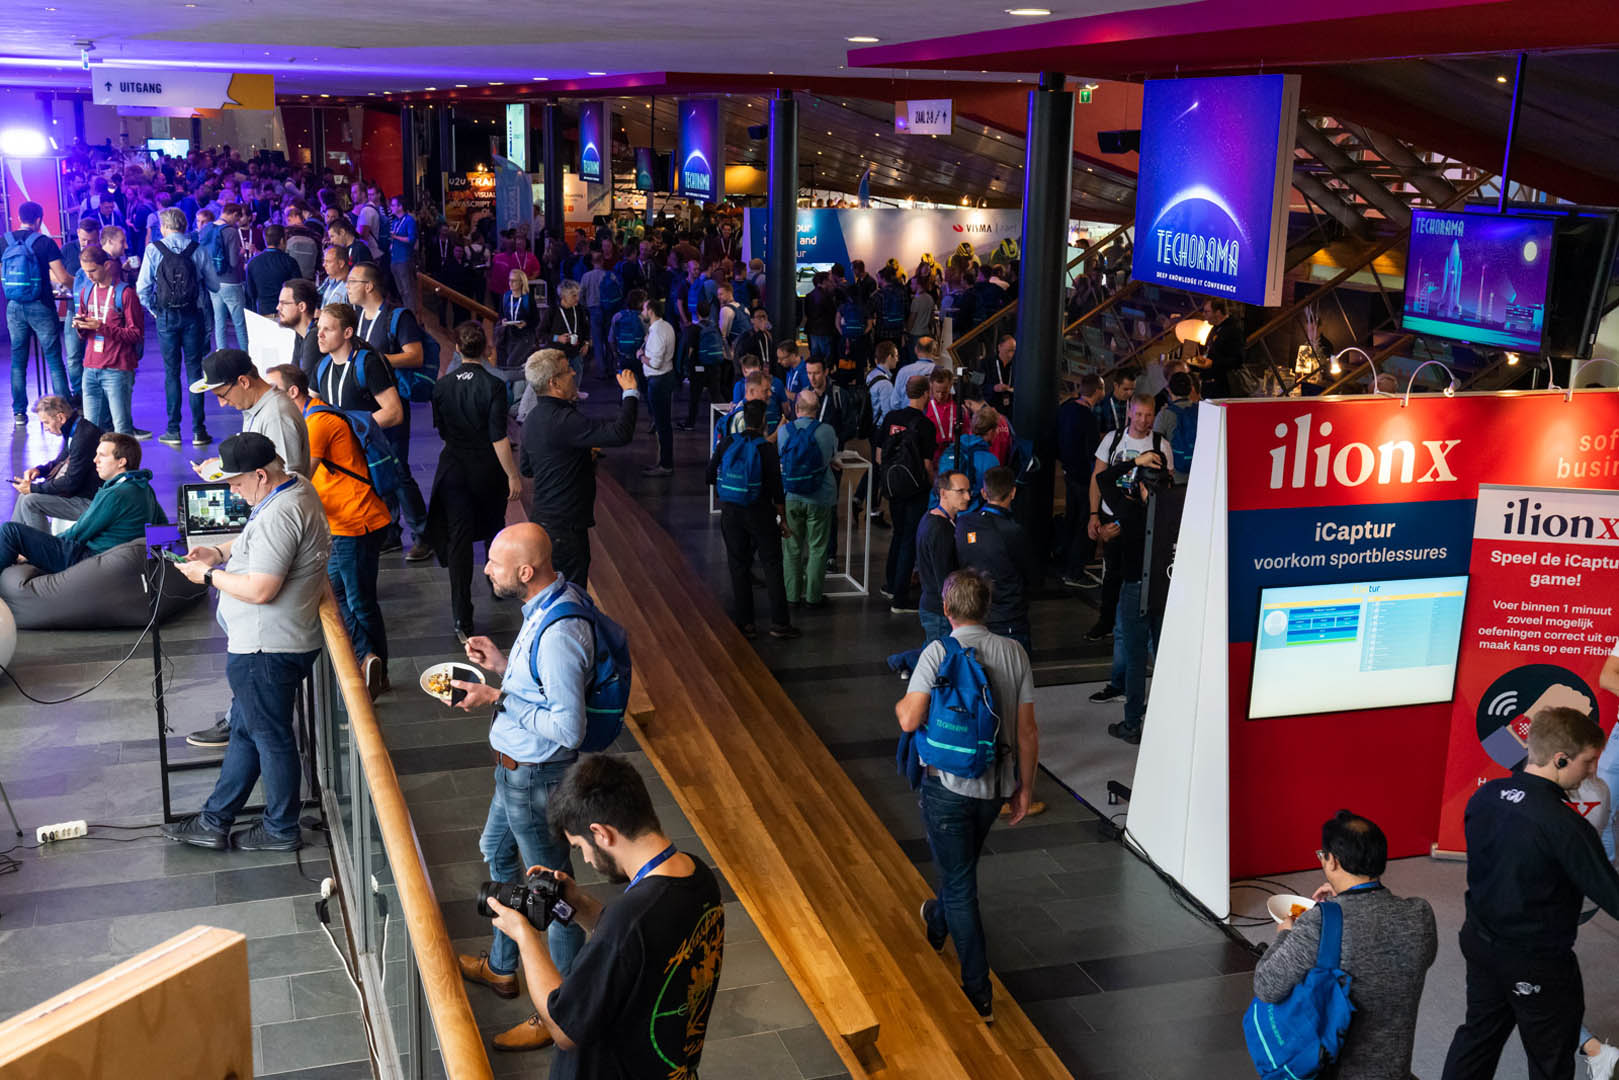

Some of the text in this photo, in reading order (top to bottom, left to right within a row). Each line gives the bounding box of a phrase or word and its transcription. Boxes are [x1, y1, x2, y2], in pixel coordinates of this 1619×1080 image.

[120, 82, 162, 94] UITGANG
[966, 223, 992, 233] VISMA
[1416, 217, 1465, 237] TECHORAMA
[800, 236, 817, 246] and
[1157, 229, 1240, 276] TECHORAMA
[1156, 271, 1237, 294] DEEP KNOWLEDGE IT CONFERENCE
[1269, 413, 1462, 489] ilionx
[1504, 498, 1619, 541] ilionx
[1315, 520, 1396, 545] iCaptur
[1254, 547, 1448, 570] voorkom sportblessures
[1490, 550, 1537, 566] Speel
[1540, 553, 1561, 566] de
[1530, 574, 1582, 588] game!
[1493, 600, 1612, 616] Voer binnen 1 minuut
[1507, 615, 1594, 630] zoveel mogelijk
[1478, 626, 1541, 639] oefeningen
[1544, 631, 1585, 641] correct
[1588, 633, 1602, 643] uit
[1479, 640, 1510, 651] maak
[1513, 641, 1540, 652] kans
[1543, 645, 1557, 655] op
[1559, 646, 1581, 655] een
